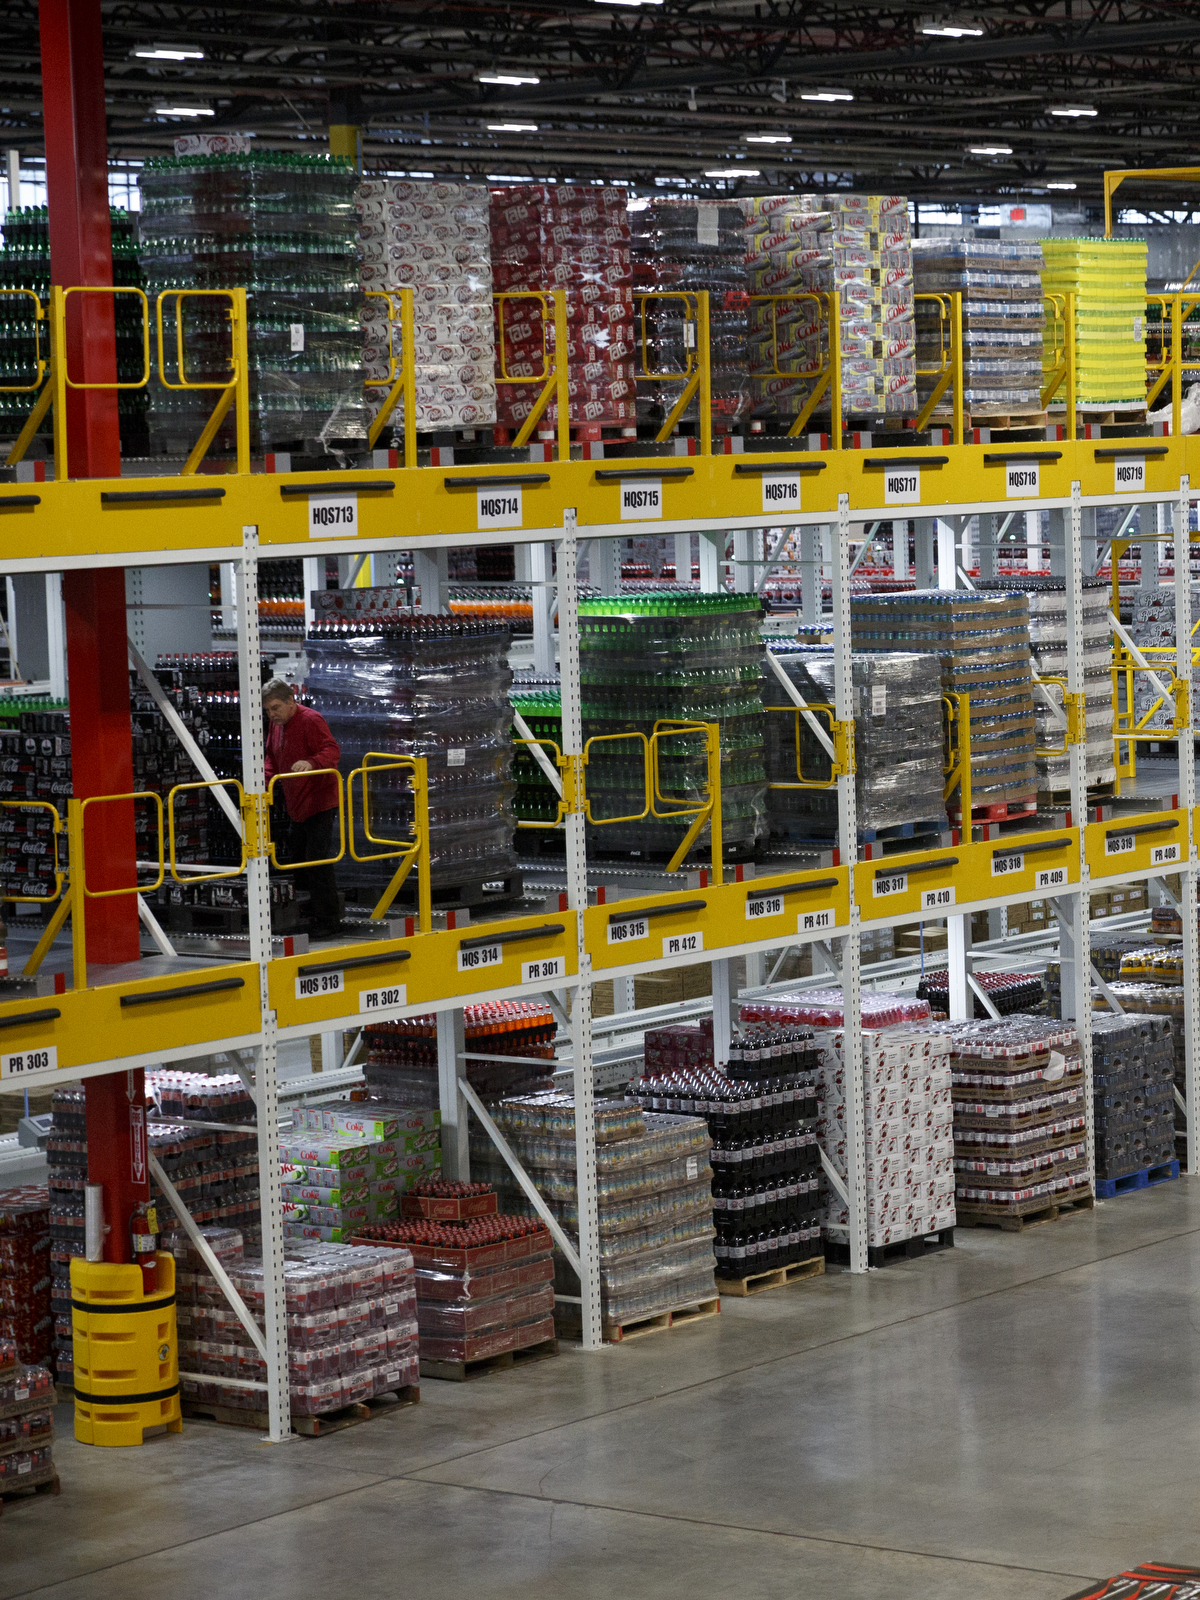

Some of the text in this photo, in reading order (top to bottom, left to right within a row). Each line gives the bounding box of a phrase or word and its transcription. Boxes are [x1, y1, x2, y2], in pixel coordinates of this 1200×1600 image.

[762, 197, 789, 214] Coke
[762, 233, 790, 251] Coke
[1009, 471, 1037, 487] HQS718
[1117, 466, 1143, 482] HQS719
[765, 483, 798, 501] HQS716
[888, 477, 917, 493] HQS717
[480, 498, 519, 517] HQS714
[624, 490, 660, 508] HQS715
[312, 506, 354, 526] HQS713
[1107, 837, 1133, 852] HQS 319
[1155, 849, 1163, 861] PR
[994, 856, 1021, 874] HQS 318
[876, 877, 904, 895] HQS 317
[1040, 870, 1063, 886] PR 409
[926, 890, 950, 906] PR 410
[749, 898, 780, 917] HQS 316
[804, 912, 829, 929] PR 411
[611, 922, 645, 941] HQS 315
[670, 936, 696, 953] PR 412
[461, 947, 498, 968] HQS 314
[529, 961, 559, 979] PR 301
[300, 974, 339, 995] HQS 313
[366, 989, 399, 1008] PR 302
[10, 1052, 49, 1073] PR 303
[962, 1059, 1009, 1070] POWERADE
[345, 1121, 364, 1132] Coke
[406, 1118, 423, 1129] Coke
[964, 1118, 1010, 1129] POWERADE
[300, 1150, 318, 1161] Coke
[967, 1175, 1014, 1188] POWERADE
